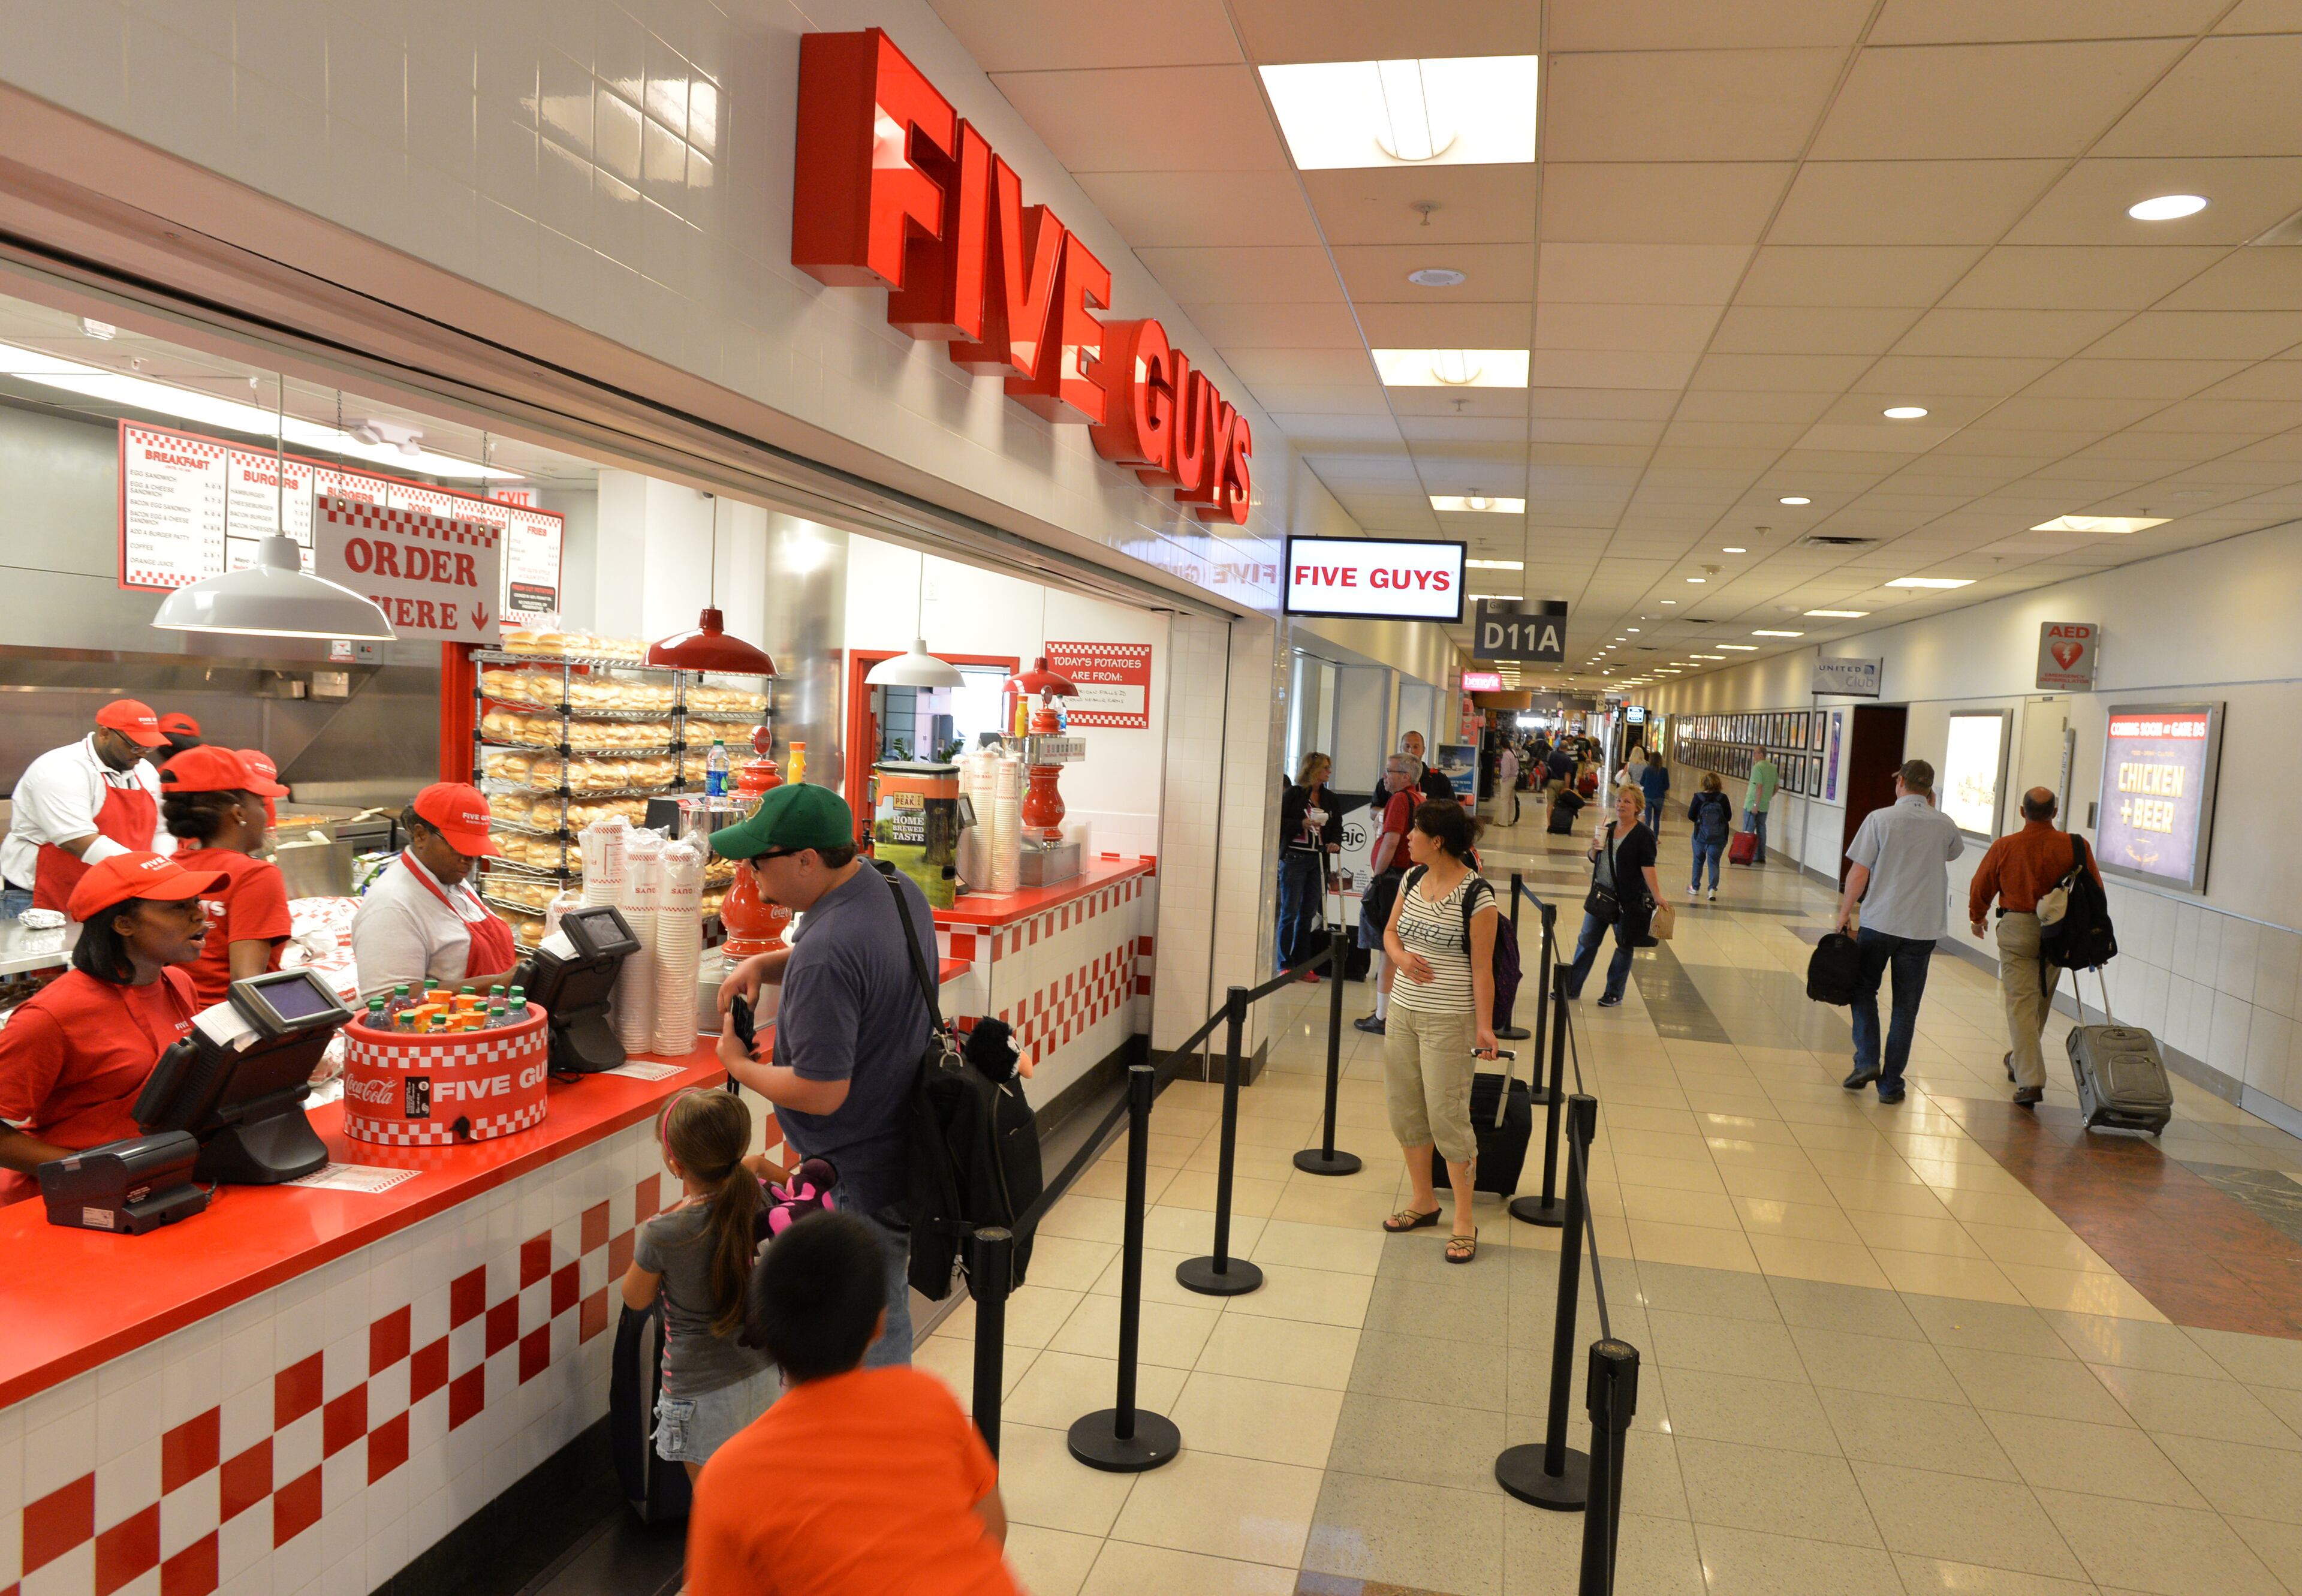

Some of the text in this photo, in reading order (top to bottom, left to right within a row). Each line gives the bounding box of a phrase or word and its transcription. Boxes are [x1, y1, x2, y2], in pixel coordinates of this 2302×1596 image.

[792, 27, 1252, 526] FIVE GUYS
[145, 449, 210, 471] BREAKFAST
[129, 469, 177, 482] EGG SANDWICH
[243, 469, 299, 490] BURGRS
[129, 487, 162, 498] SANDWICH
[151, 484, 175, 493] CHEESE
[327, 487, 374, 503] BURGERS
[129, 510, 149, 519] BACON
[164, 504, 192, 513] SANDWICH
[408, 502, 432, 515] DOGS
[129, 517, 159, 526] SANDWICH
[527, 526, 547, 537] FRIES
[130, 543, 154, 551] COFFEE
[130, 557, 156, 566] ORANGE
[345, 538, 478, 587] ORDER
[1295, 565, 1450, 591] FIVE GUYS
[1484, 622, 1560, 652] D11A
[2048, 625, 2090, 639] AED
[1053, 657, 1142, 668] TODAY'S POTATOES
[1071, 671, 1123, 682] ARE FROM:
[1465, 674, 1499, 689] benefit
[1846, 675, 1873, 688] Club
[2110, 722, 2140, 736] COMING
[2140, 722, 2163, 736] SOON
[2171, 721, 2193, 737] GATE
[2193, 721, 2205, 737] D5
[2118, 762, 2185, 799] CHICKEN
[462, 812, 480, 821] FIVE
[893, 816, 924, 826] HOME
[2132, 798, 2175, 835] BEER
[893, 824, 924, 833] BREWED
[893, 832, 924, 842] TASTE
[1342, 829, 1364, 846] ajc
[140, 857, 166, 870] FIVE
[174, 1020, 189, 1031] FIVE
[346, 1073, 398, 1104] Coca-Cola
[433, 1074, 511, 1102] FIVE
